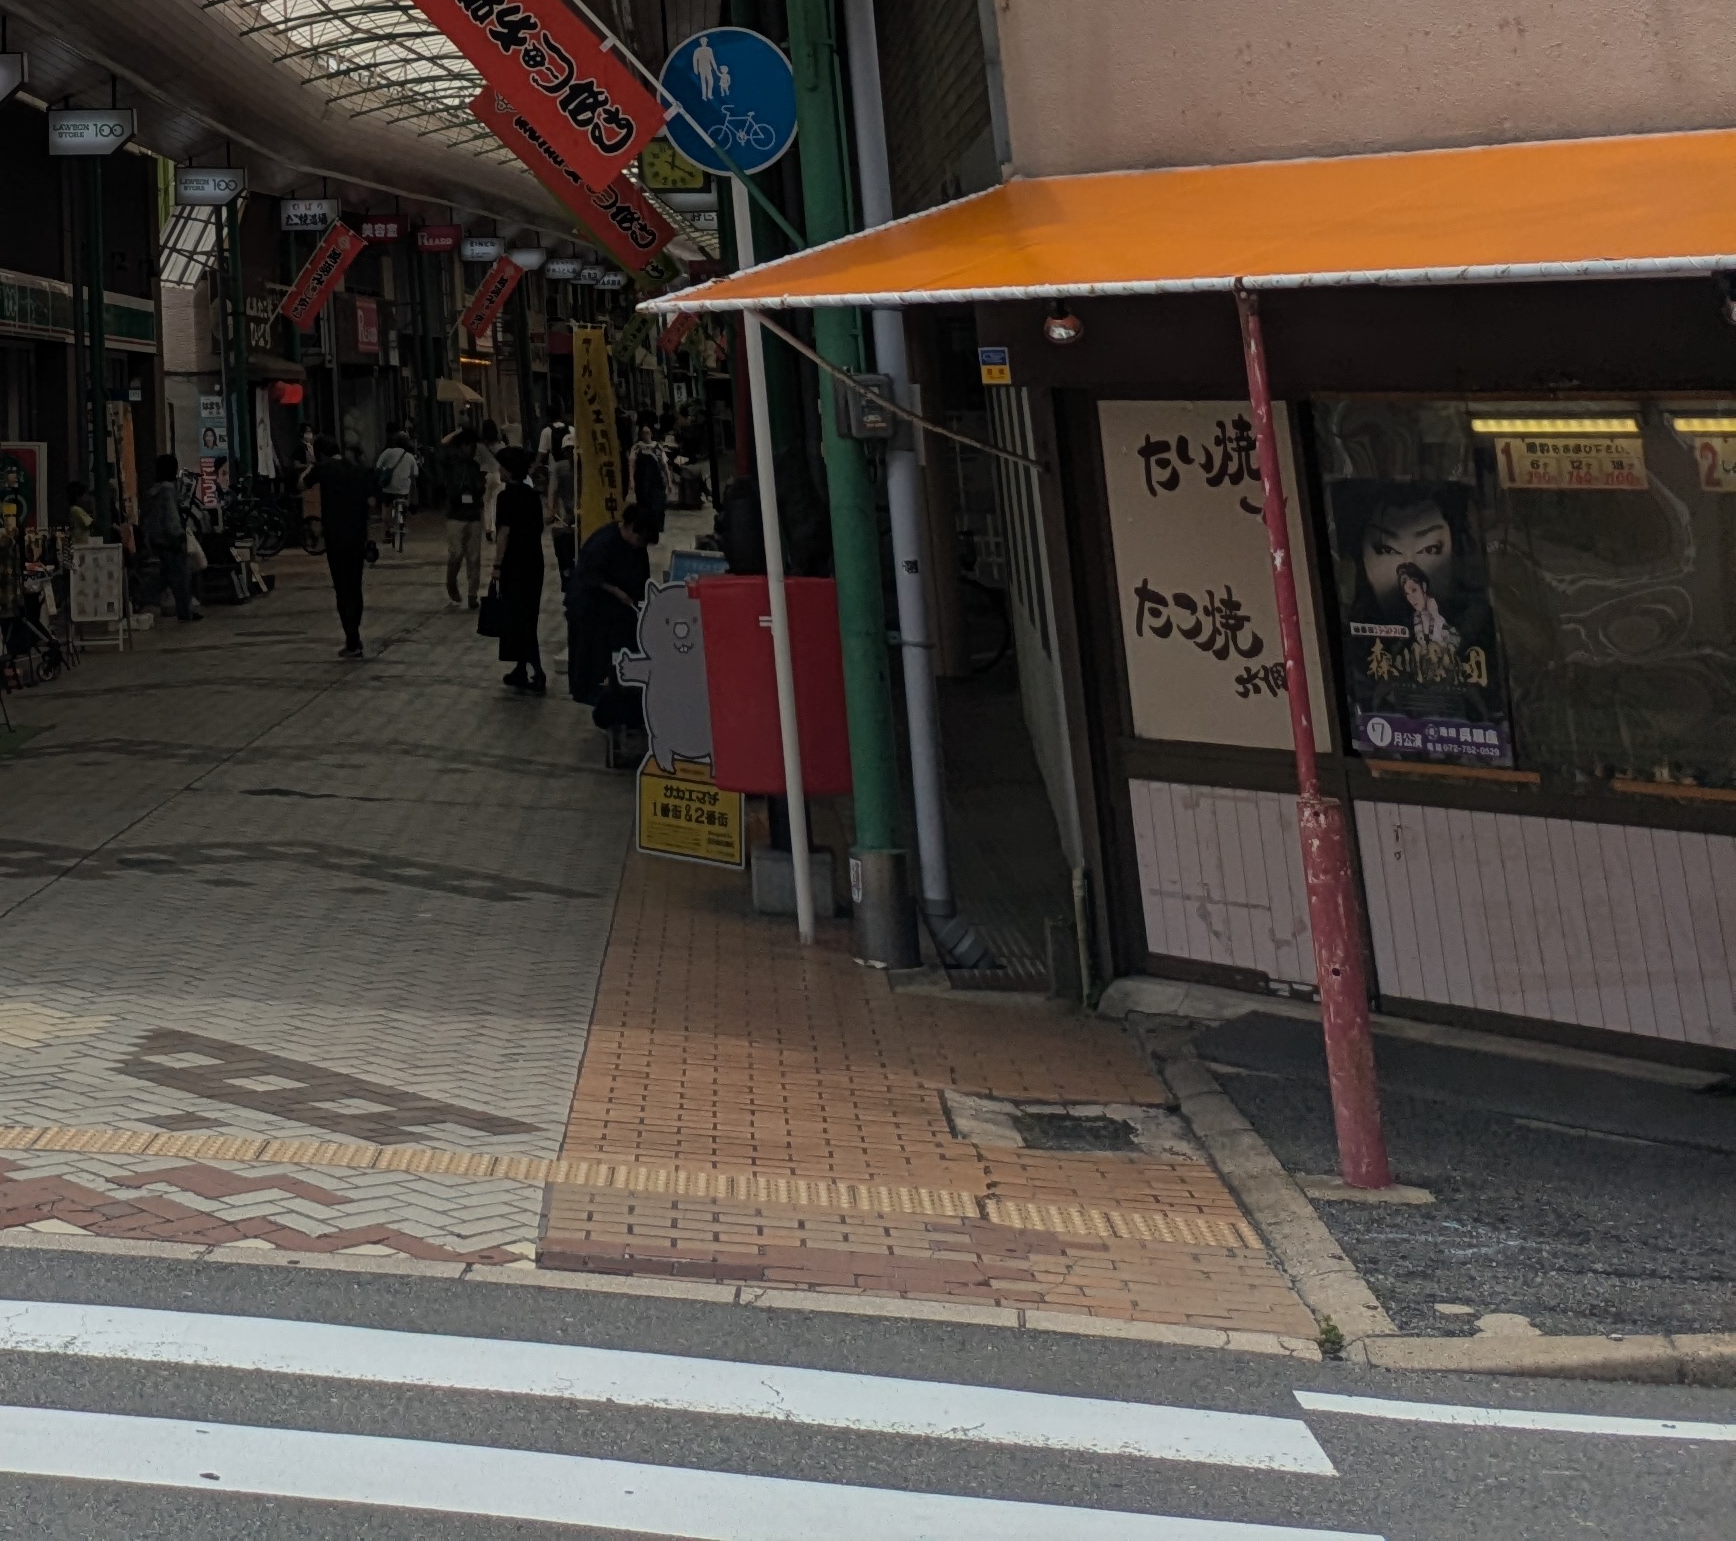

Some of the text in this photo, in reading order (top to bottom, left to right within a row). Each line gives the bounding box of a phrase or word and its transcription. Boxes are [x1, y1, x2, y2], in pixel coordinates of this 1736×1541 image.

[93, 122, 126, 139] 100
[360, 222, 399, 239] 美容室
[1133, 576, 1265, 662] たこ焼
